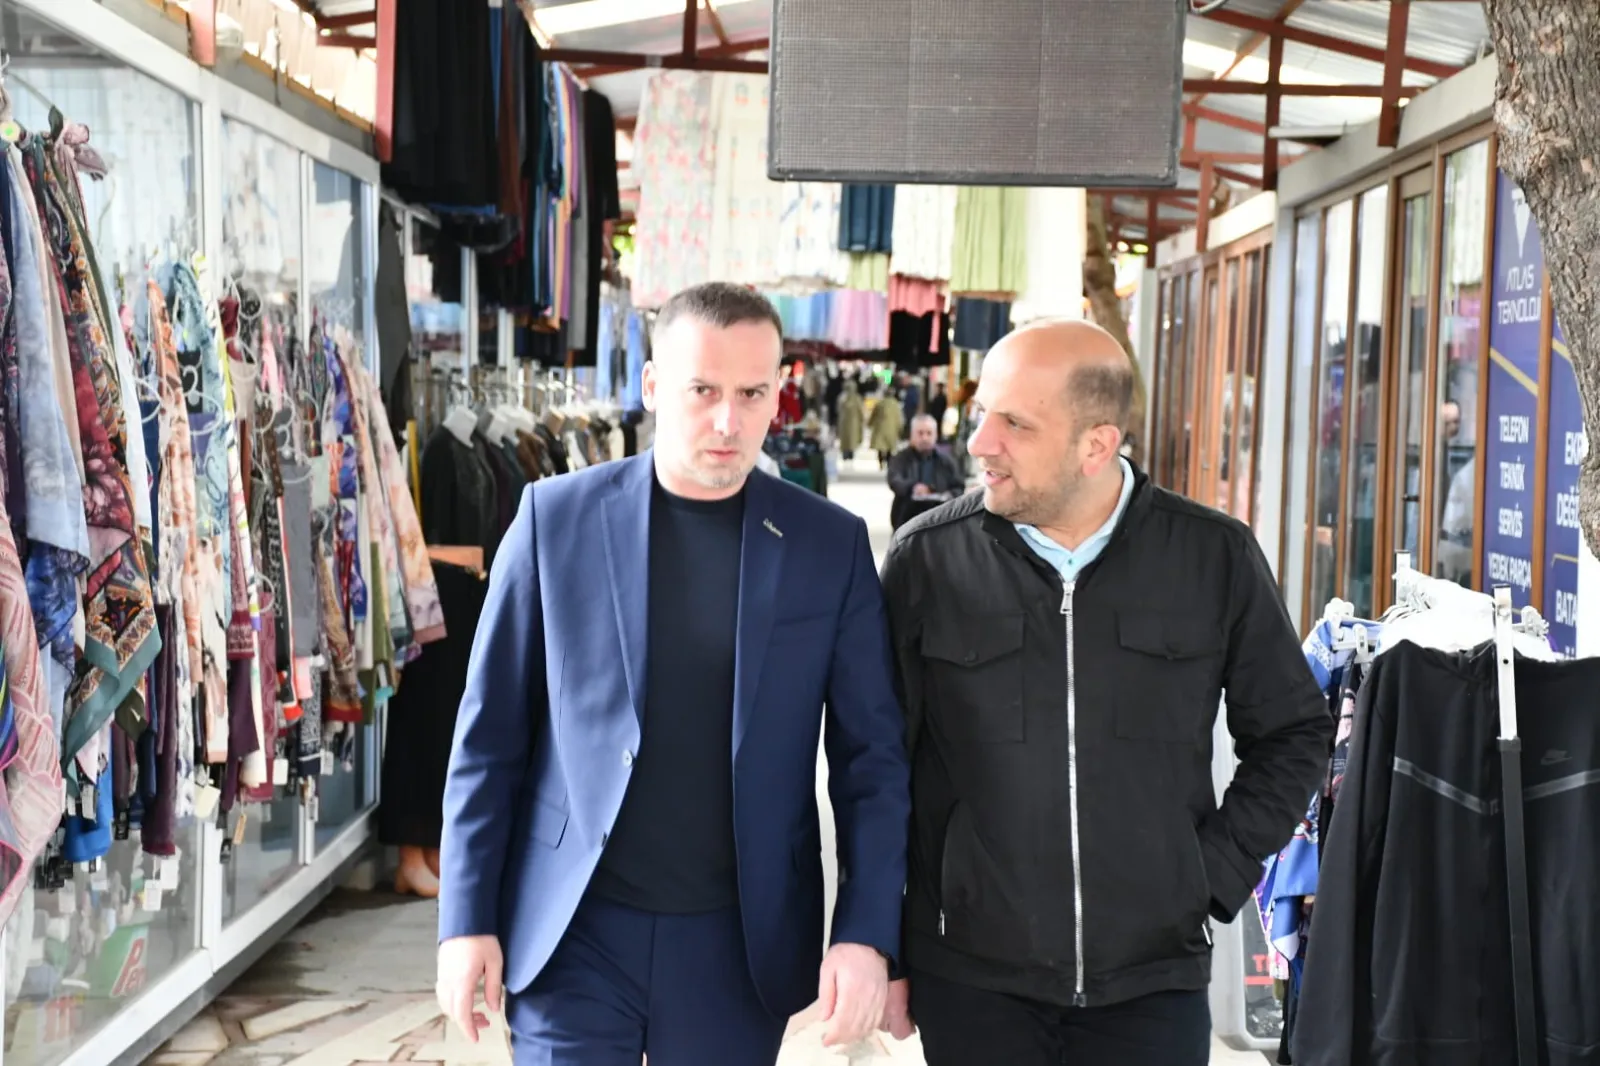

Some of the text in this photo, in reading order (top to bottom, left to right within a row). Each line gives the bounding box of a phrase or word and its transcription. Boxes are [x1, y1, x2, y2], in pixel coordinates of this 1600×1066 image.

[1505, 264, 1534, 292] ATLAS
[1499, 415, 1529, 444] TELEFON
[1499, 454, 1525, 491] TEKNİK
[1498, 502, 1523, 538] SERVİS
[1488, 551, 1532, 593] YEDEK PARÇA
